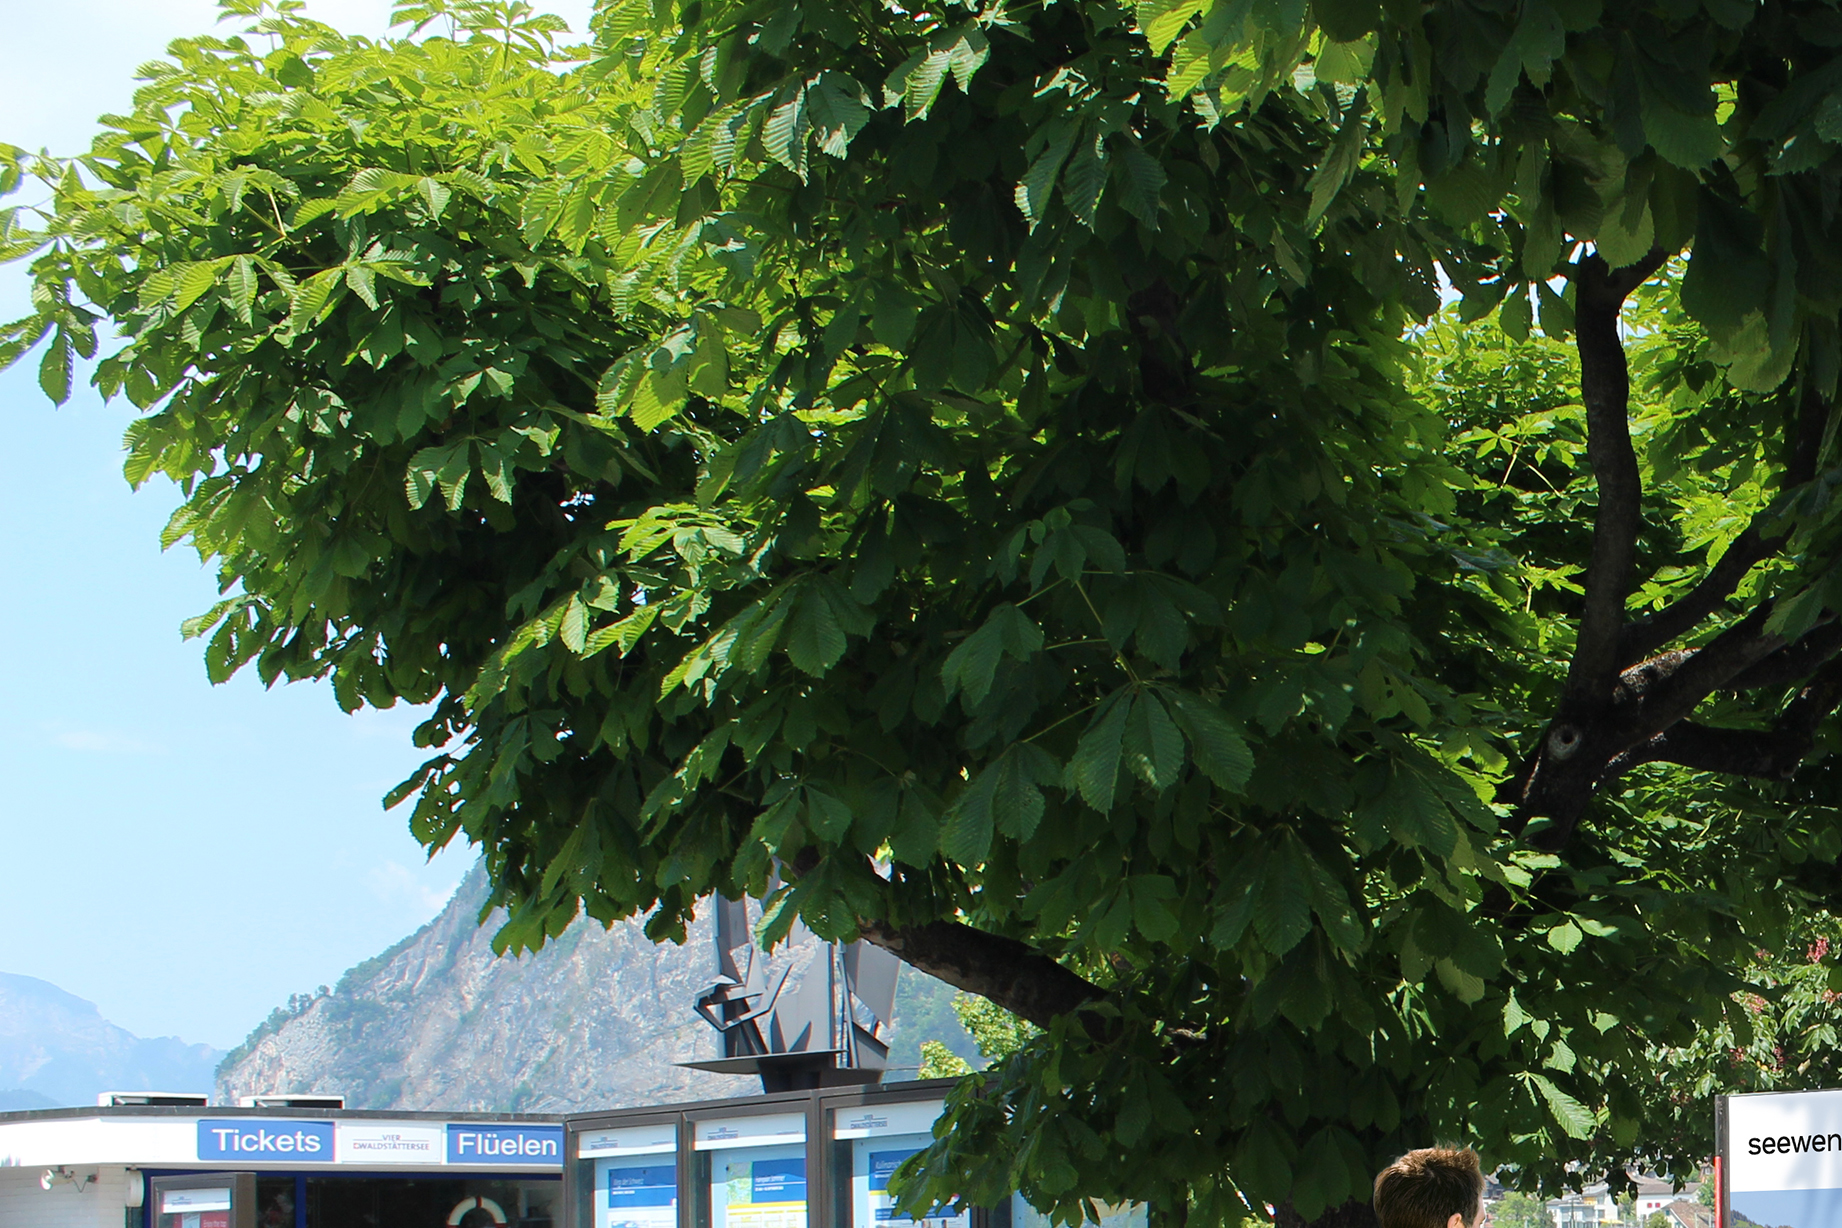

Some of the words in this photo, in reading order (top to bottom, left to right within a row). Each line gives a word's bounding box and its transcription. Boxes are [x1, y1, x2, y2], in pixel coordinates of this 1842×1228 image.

[211, 1128, 321, 1152] Tickets
[357, 1142, 430, 1151] WALDSTÄTTERSEE
[382, 1134, 401, 1142] VIER
[457, 1133, 558, 1156] Flüelen
[1748, 1133, 1842, 1155] seewen
